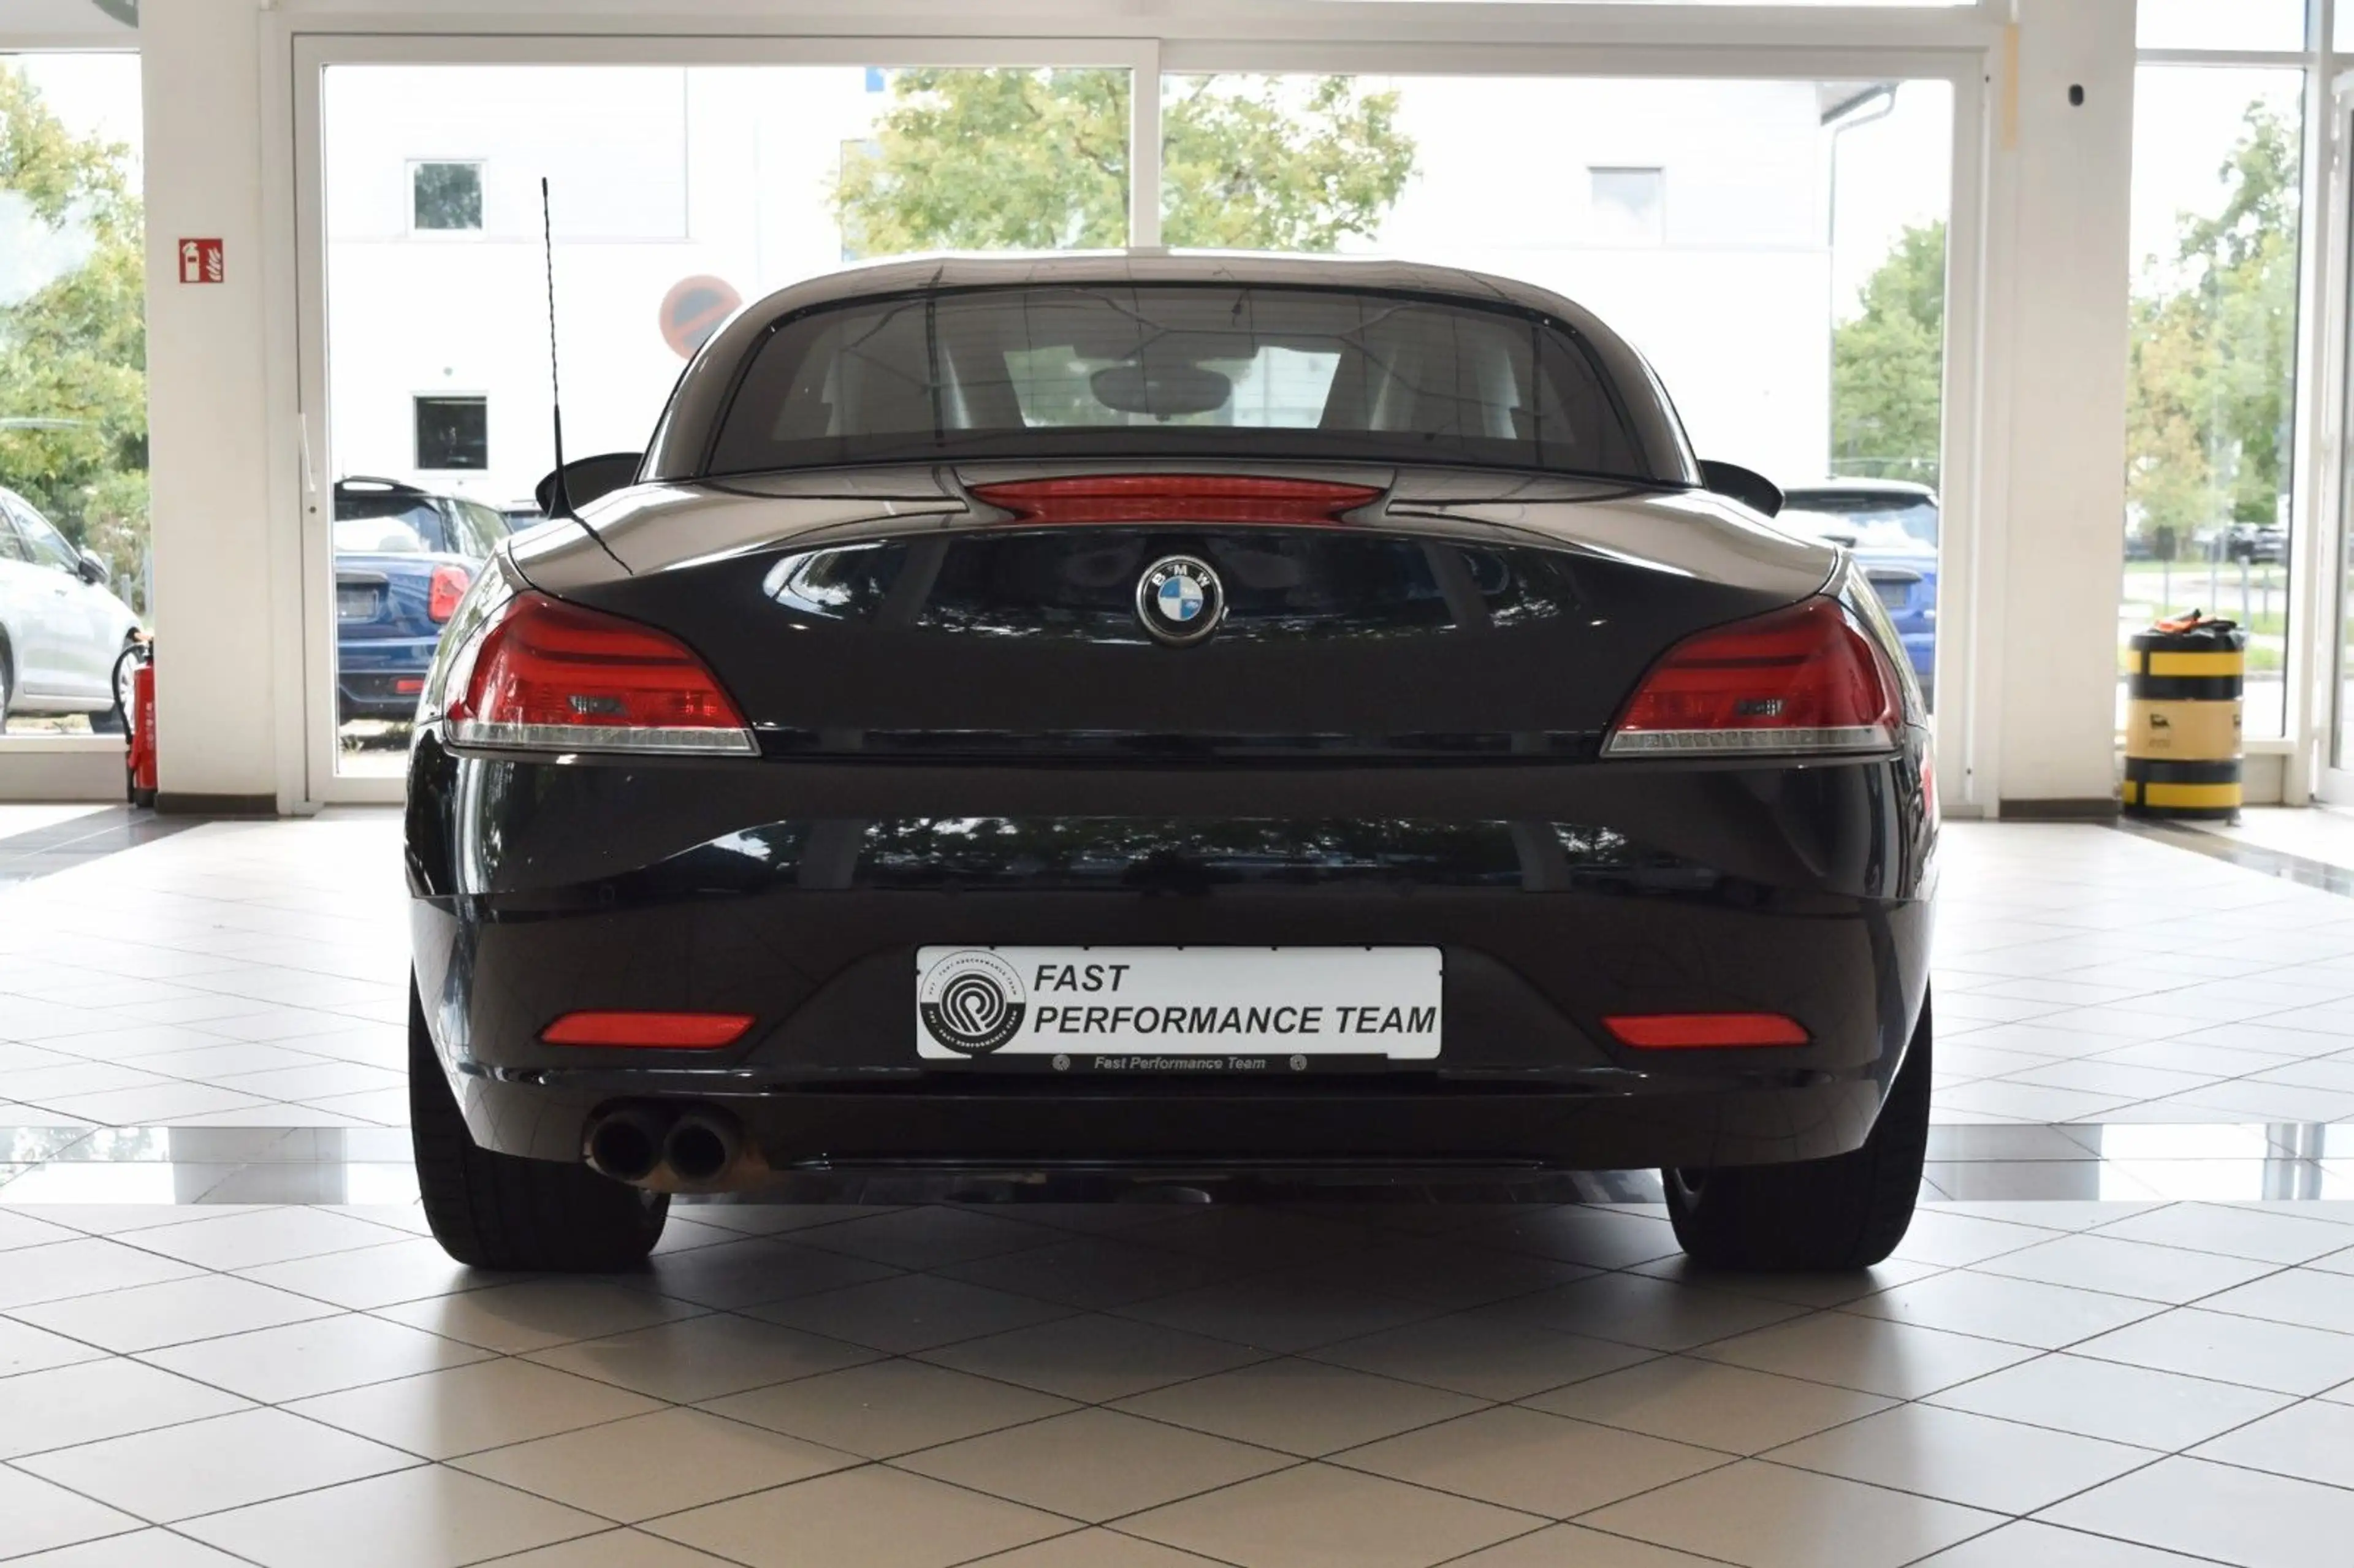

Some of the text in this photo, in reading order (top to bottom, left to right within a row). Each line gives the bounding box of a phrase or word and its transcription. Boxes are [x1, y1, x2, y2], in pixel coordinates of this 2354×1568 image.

[1152, 564, 1210, 587] BMW
[1034, 964, 1130, 992] FAST
[1034, 1006, 1323, 1033] PERFORMANCE
[1336, 1006, 1436, 1033] TEAM
[1094, 1056, 1265, 1069] Fast Performance Team
